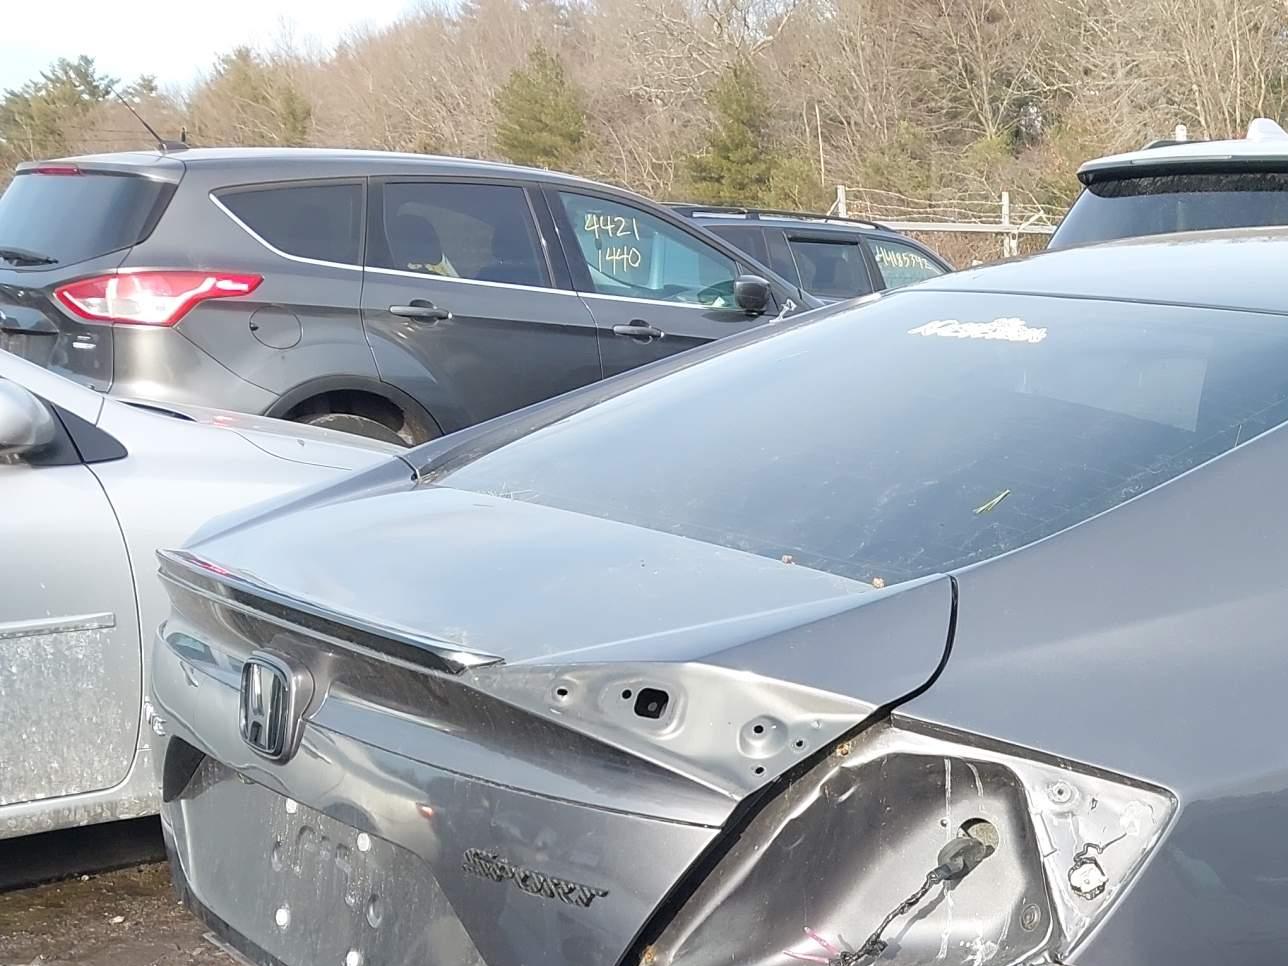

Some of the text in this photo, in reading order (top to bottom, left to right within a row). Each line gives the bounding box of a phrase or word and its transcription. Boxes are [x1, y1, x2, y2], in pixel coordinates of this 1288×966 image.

[584, 213, 640, 241] 4421
[597, 246, 641, 276] 1440
[462, 848, 609, 908] SPORT
